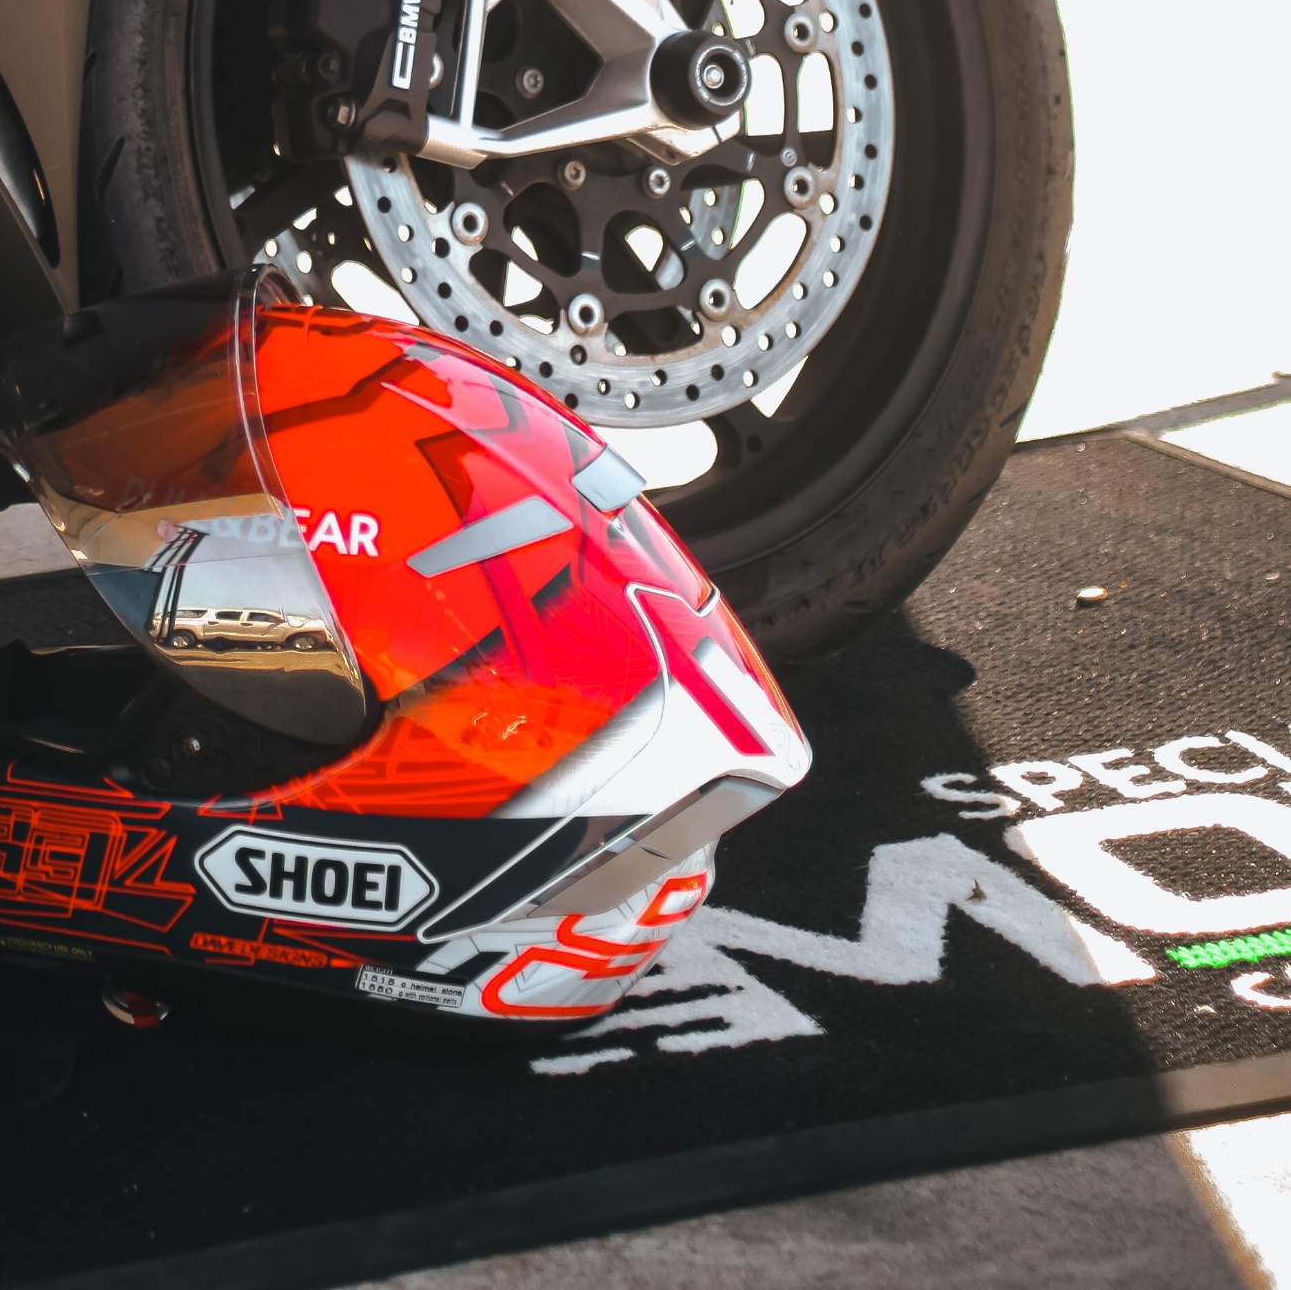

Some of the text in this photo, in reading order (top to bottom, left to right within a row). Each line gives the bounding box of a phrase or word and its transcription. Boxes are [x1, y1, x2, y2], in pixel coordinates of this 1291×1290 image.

[234, 846, 402, 913] SHOEI
[71, 947, 93, 958] ONLY
[363, 973, 395, 986] 1515
[410, 982, 438, 993] helmet
[441, 987, 463, 997] alone
